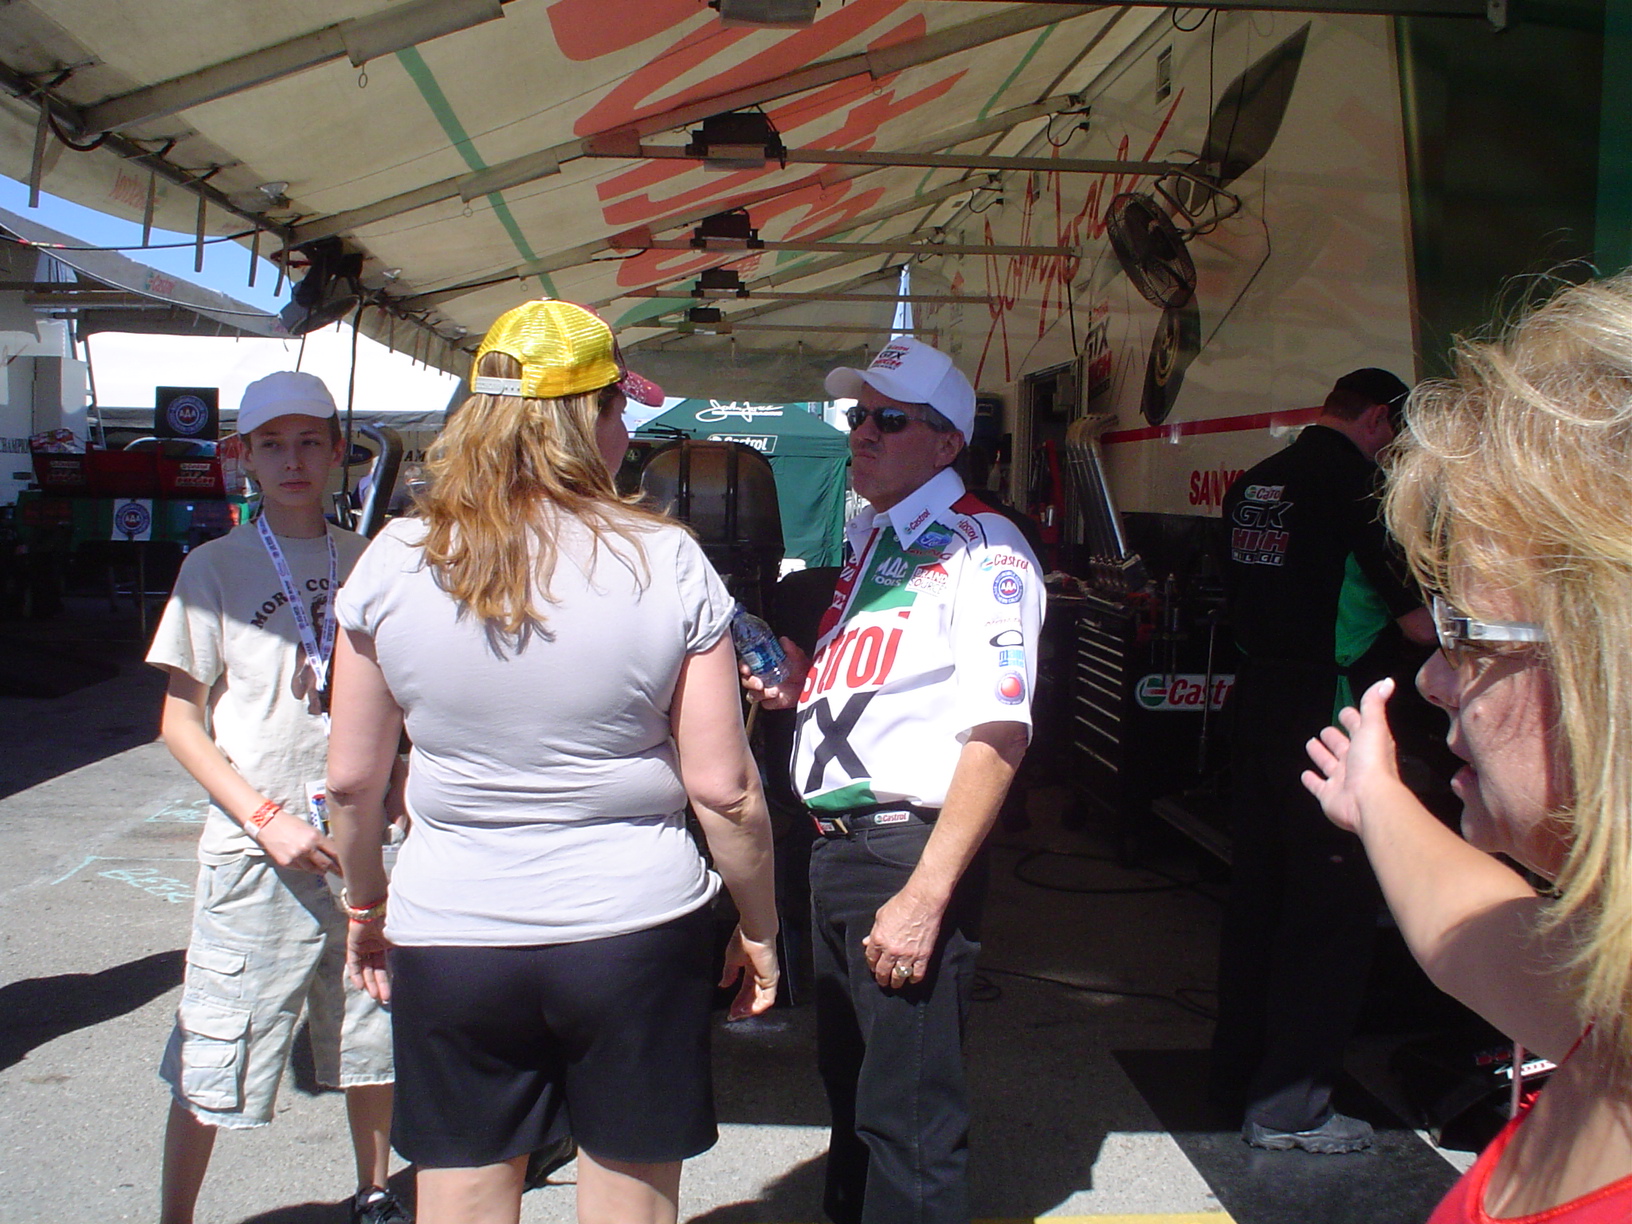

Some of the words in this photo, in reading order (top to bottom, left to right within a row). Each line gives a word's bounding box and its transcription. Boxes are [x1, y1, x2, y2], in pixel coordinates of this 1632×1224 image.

[179, 408, 197, 418] AAA
[1189, 469, 1245, 506] SANY
[125, 514, 141, 523] AAA
[910, 508, 931, 531] Castrol
[1232, 528, 1290, 554] HIH
[995, 553, 1029, 572] Castrol
[999, 581, 1017, 591] AAA
[882, 812, 908, 822] Castrol
